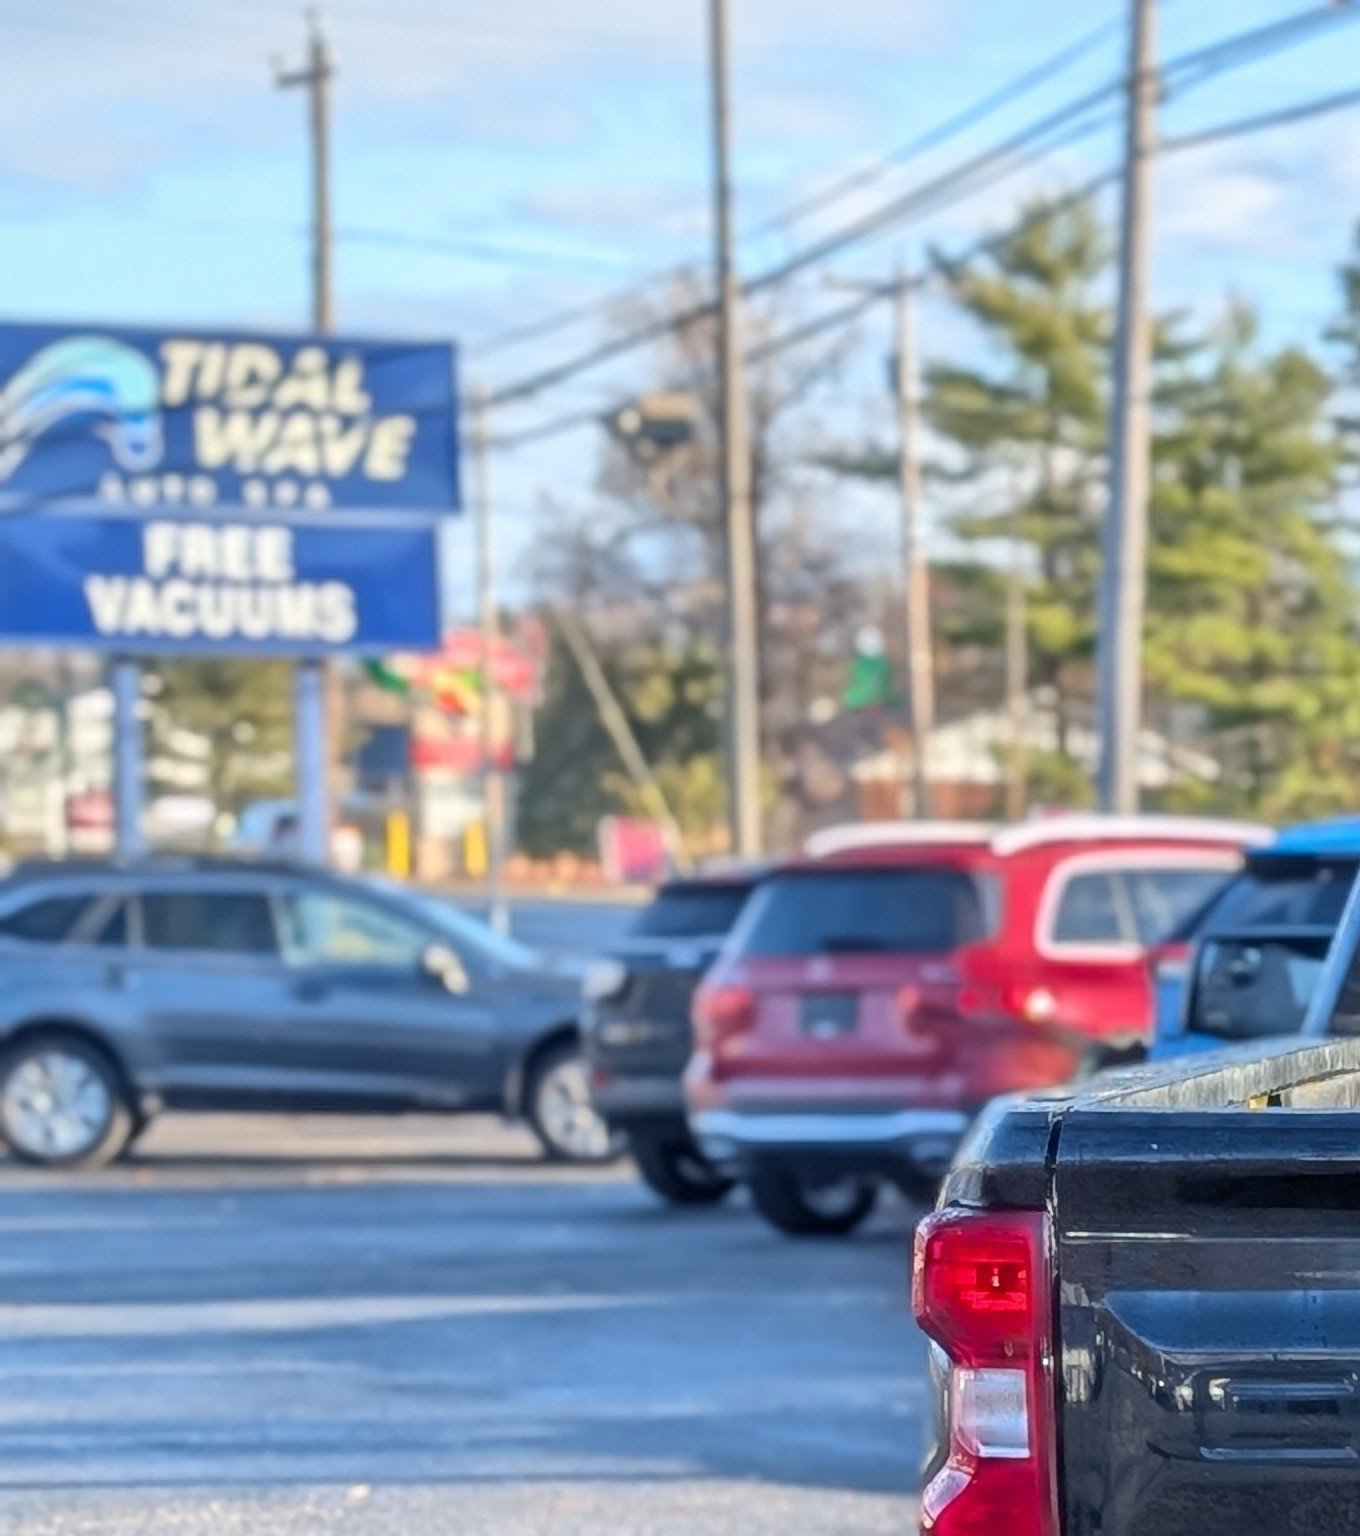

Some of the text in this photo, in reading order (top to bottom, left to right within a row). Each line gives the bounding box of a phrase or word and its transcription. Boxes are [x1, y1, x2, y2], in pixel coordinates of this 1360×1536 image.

[161, 340, 372, 416] TIDAL
[194, 407, 416, 480] WAVE
[143, 523, 294, 580] FREE
[84, 574, 357, 642] VACUUMS
